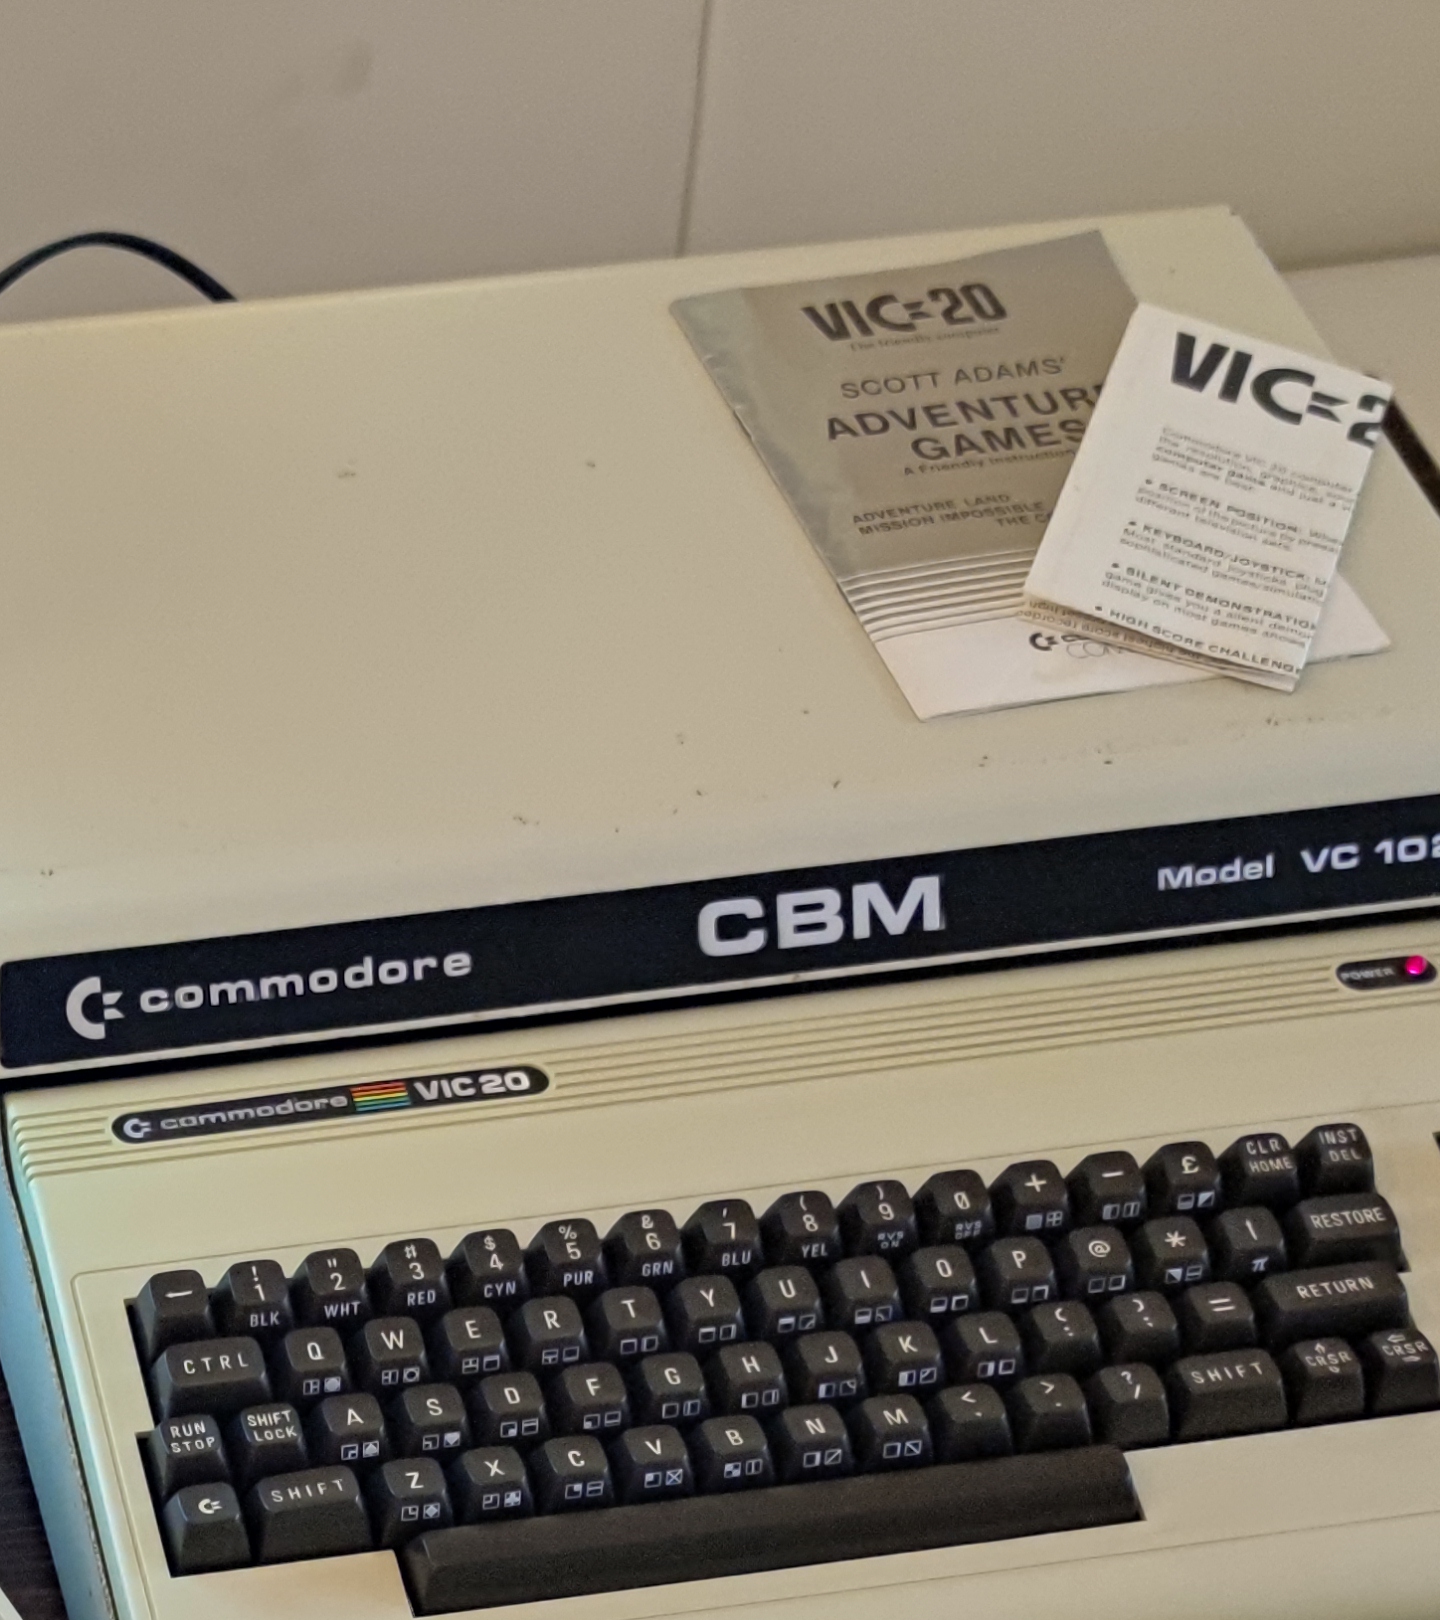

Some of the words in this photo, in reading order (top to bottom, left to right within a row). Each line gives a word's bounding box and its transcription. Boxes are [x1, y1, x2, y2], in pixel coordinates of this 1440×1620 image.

[840, 372, 940, 399] SCOTT
[954, 356, 1066, 386] ADAMS'
[828, 384, 1100, 441] ADVENTUR
[911, 419, 1086, 460] GAMES
[904, 466, 915, 476] A
[917, 459, 985, 474] Friendly
[1159, 482, 1221, 509] SCREEN
[852, 501, 955, 523] ADVENTURE
[963, 493, 1011, 507] LAND
[858, 515, 935, 535] MISSION
[939, 501, 1045, 522] IMPOSSIBLE
[995, 515, 1029, 527] THE
[1126, 566, 1181, 591] SILENT
[1109, 609, 1149, 629] HIGH
[1152, 625, 1204, 647] SCORE
[139, 951, 473, 1014] commodore
[697, 874, 945, 958] CBM
[1156, 852, 1277, 892] Model
[1300, 844, 1361, 876] VC
[1340, 968, 1395, 980] POWER
[160, 1093, 348, 1131] commodore
[414, 1076, 480, 1101] VIC
[479, 1070, 530, 1095] 20
[1320, 1127, 1359, 1145] INST
[1245, 1137, 1281, 1156] CLR
[1328, 1146, 1361, 1162] DEL
[1249, 1154, 1294, 1173] HOME
[1309, 1205, 1386, 1231] RESTORE
[720, 1250, 752, 1267] BLU
[800, 1241, 829, 1258] YEL
[562, 1269, 595, 1287] PUR
[641, 1260, 673, 1278] GRN
[483, 1279, 517, 1298] CYN
[1296, 1276, 1374, 1300] RETURN
[406, 1289, 437, 1307] RED
[248, 1312, 281, 1327] BLK
[323, 1301, 362, 1319] WHT
[1382, 1340, 1429, 1357] CRSR
[182, 1350, 250, 1376] CTRL
[1306, 1351, 1351, 1368] CRSR
[1190, 1361, 1264, 1383] SHIFT
[246, 1409, 293, 1428] SHIFT
[169, 1420, 206, 1439] RUN
[252, 1423, 298, 1442] LOCK
[169, 1435, 216, 1454] STOP
[270, 1477, 345, 1503] SHIFT
